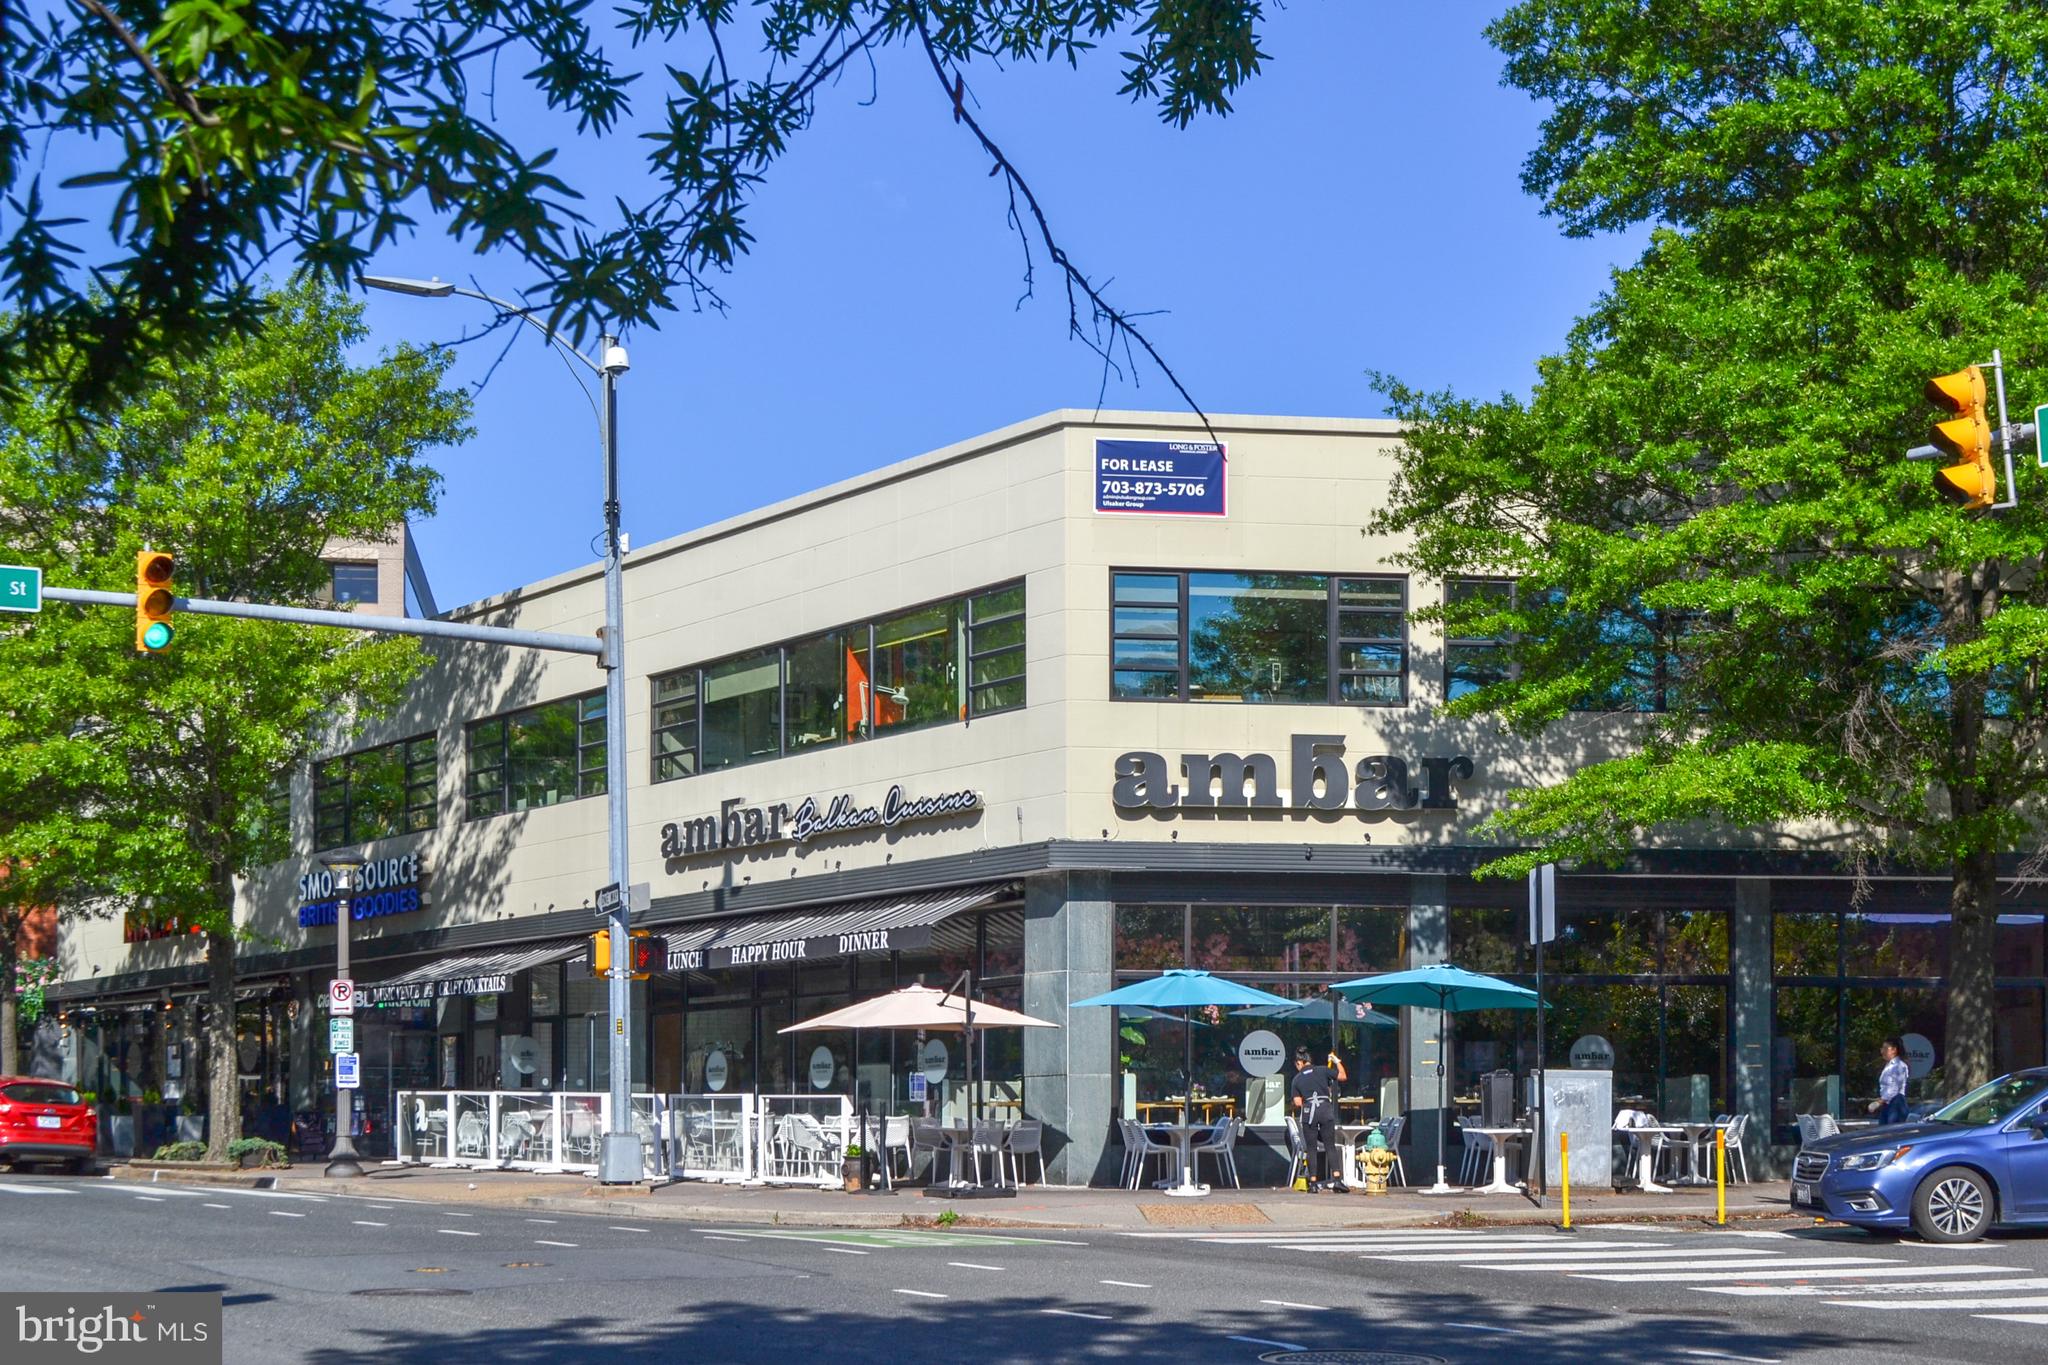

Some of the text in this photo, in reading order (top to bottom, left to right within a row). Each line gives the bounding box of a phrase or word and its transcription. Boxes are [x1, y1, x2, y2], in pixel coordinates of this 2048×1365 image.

[1169, 443, 1188, 451] LONG
[1195, 444, 1217, 452] FOSTER
[1101, 458, 1173, 473] FOR LEASE
[1102, 480, 1205, 496] 703-873-5706
[9, 581, 27, 596] St
[1112, 733, 1474, 811] ambar
[660, 784, 978, 859] ambar Balkan Cuisine
[355, 853, 418, 893] SOURCE
[298, 888, 418, 928] BRITIS GOODIES
[731, 940, 806, 965] HAPPY HOUR
[838, 930, 889, 954] DINNER
[667, 950, 703, 971] LUNCH
[438, 980, 463, 996] CRAFT
[463, 975, 506, 994] COCKTAILS
